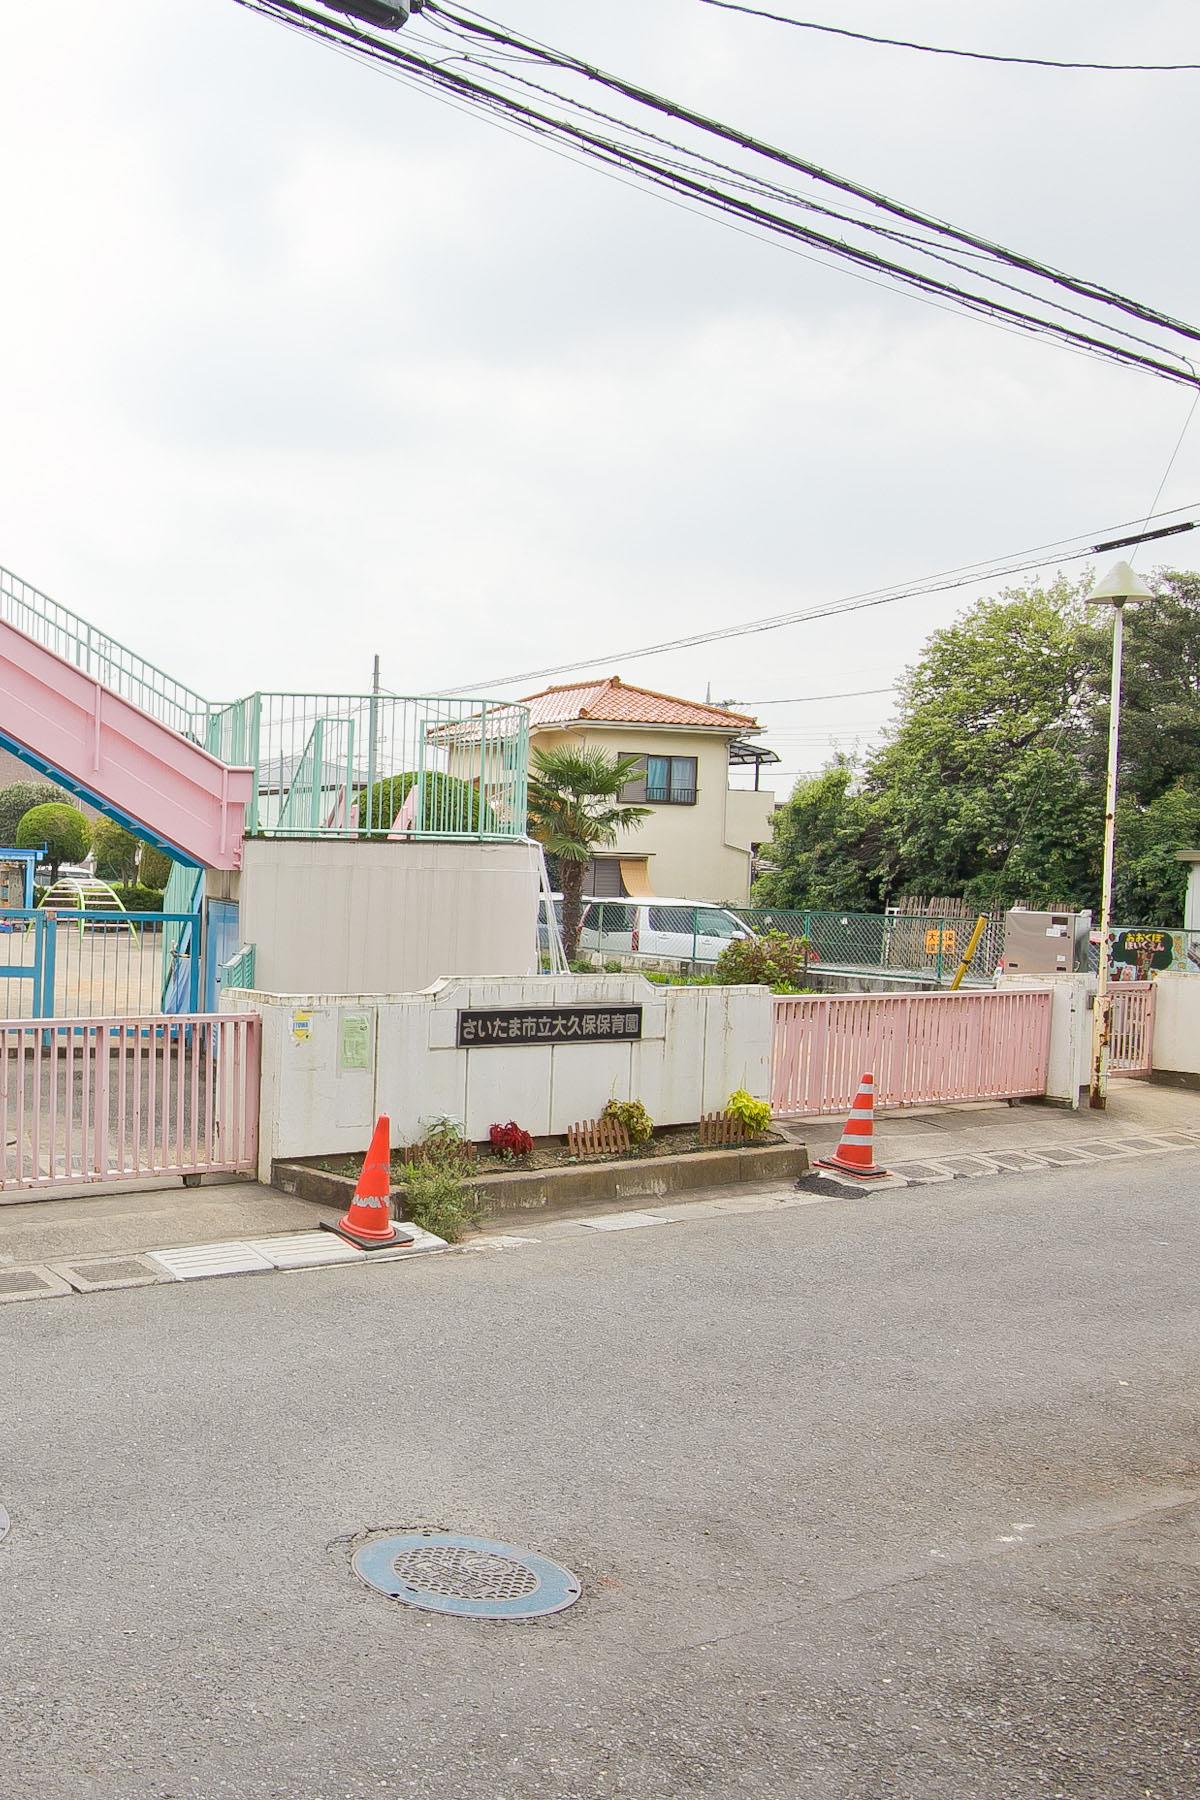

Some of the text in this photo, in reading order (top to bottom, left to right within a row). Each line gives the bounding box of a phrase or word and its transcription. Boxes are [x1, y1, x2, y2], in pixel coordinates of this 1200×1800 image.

[1126, 932, 1164, 942] おおくぼ
[1124, 941, 1165, 952] ほいくえん
[462, 1013, 639, 1039] さいたま市立大久保保育園
